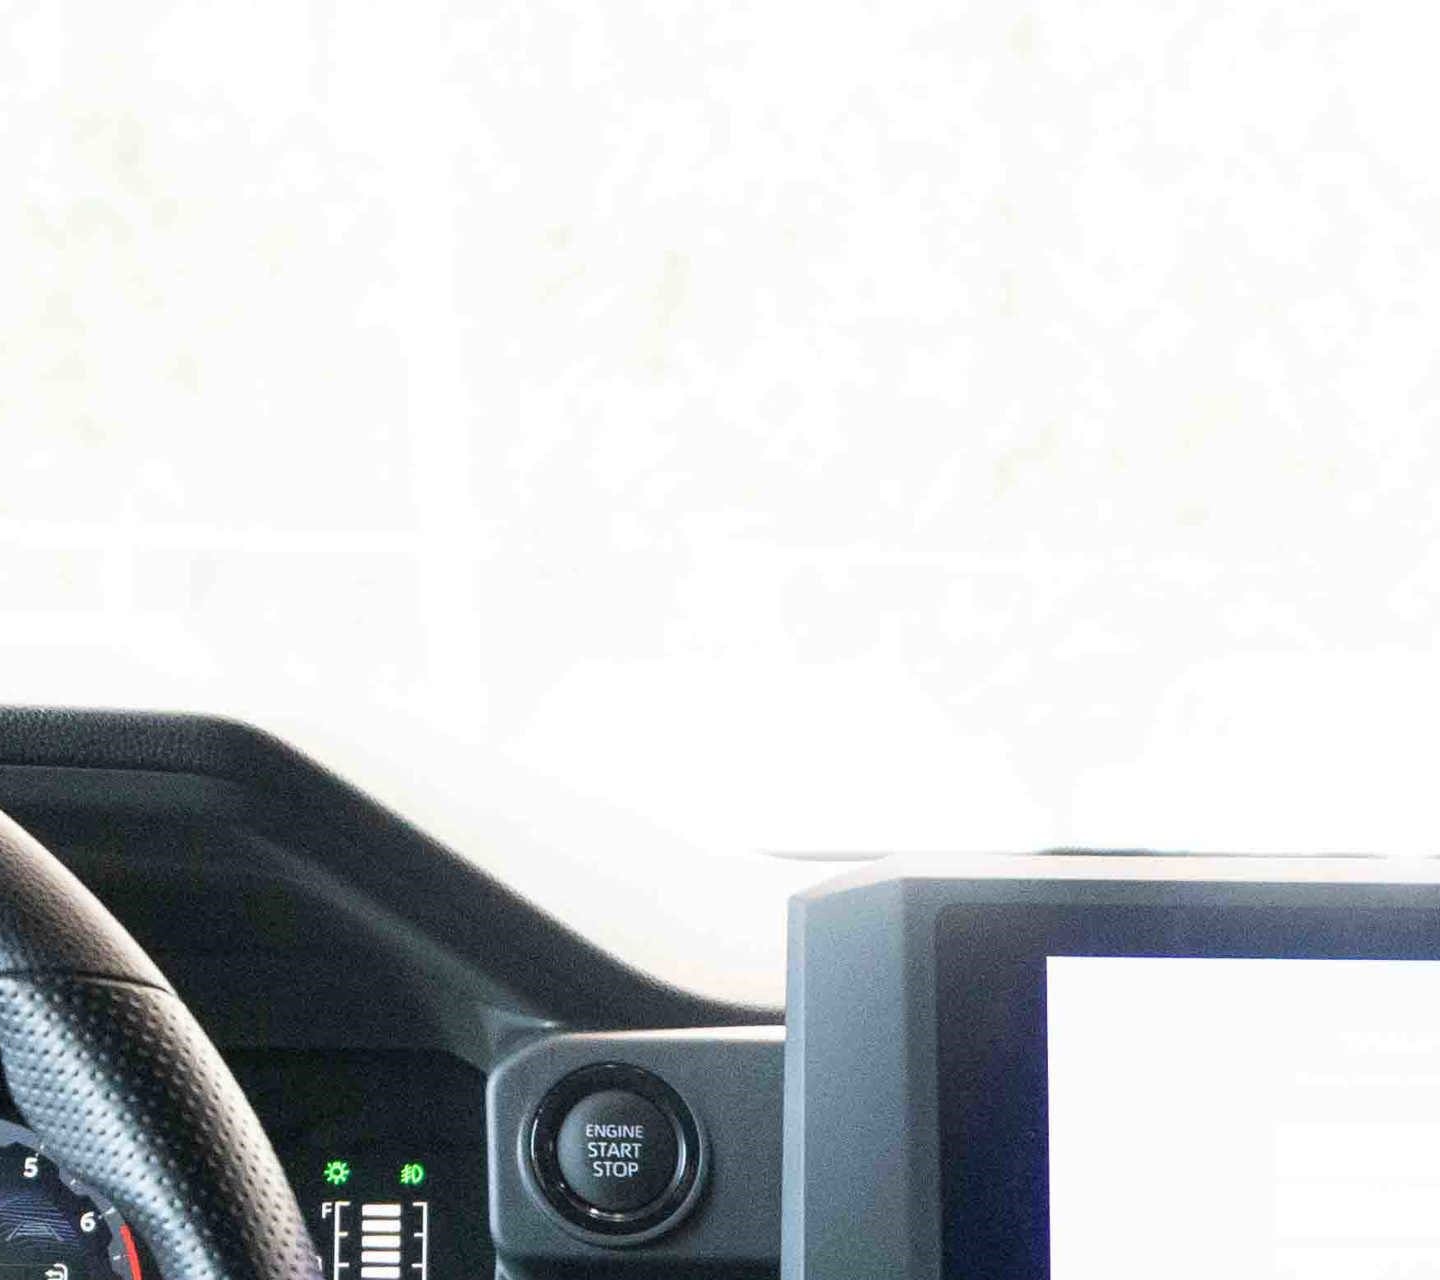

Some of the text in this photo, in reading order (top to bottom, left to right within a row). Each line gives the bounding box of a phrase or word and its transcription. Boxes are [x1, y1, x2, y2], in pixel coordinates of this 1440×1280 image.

[585, 1124, 645, 1138] ENGINE
[587, 1142, 642, 1159] START
[23, 1156, 39, 1178] 5
[592, 1160, 639, 1178] STOP
[321, 1202, 333, 1219] F
[79, 1211, 95, 1232] 6
